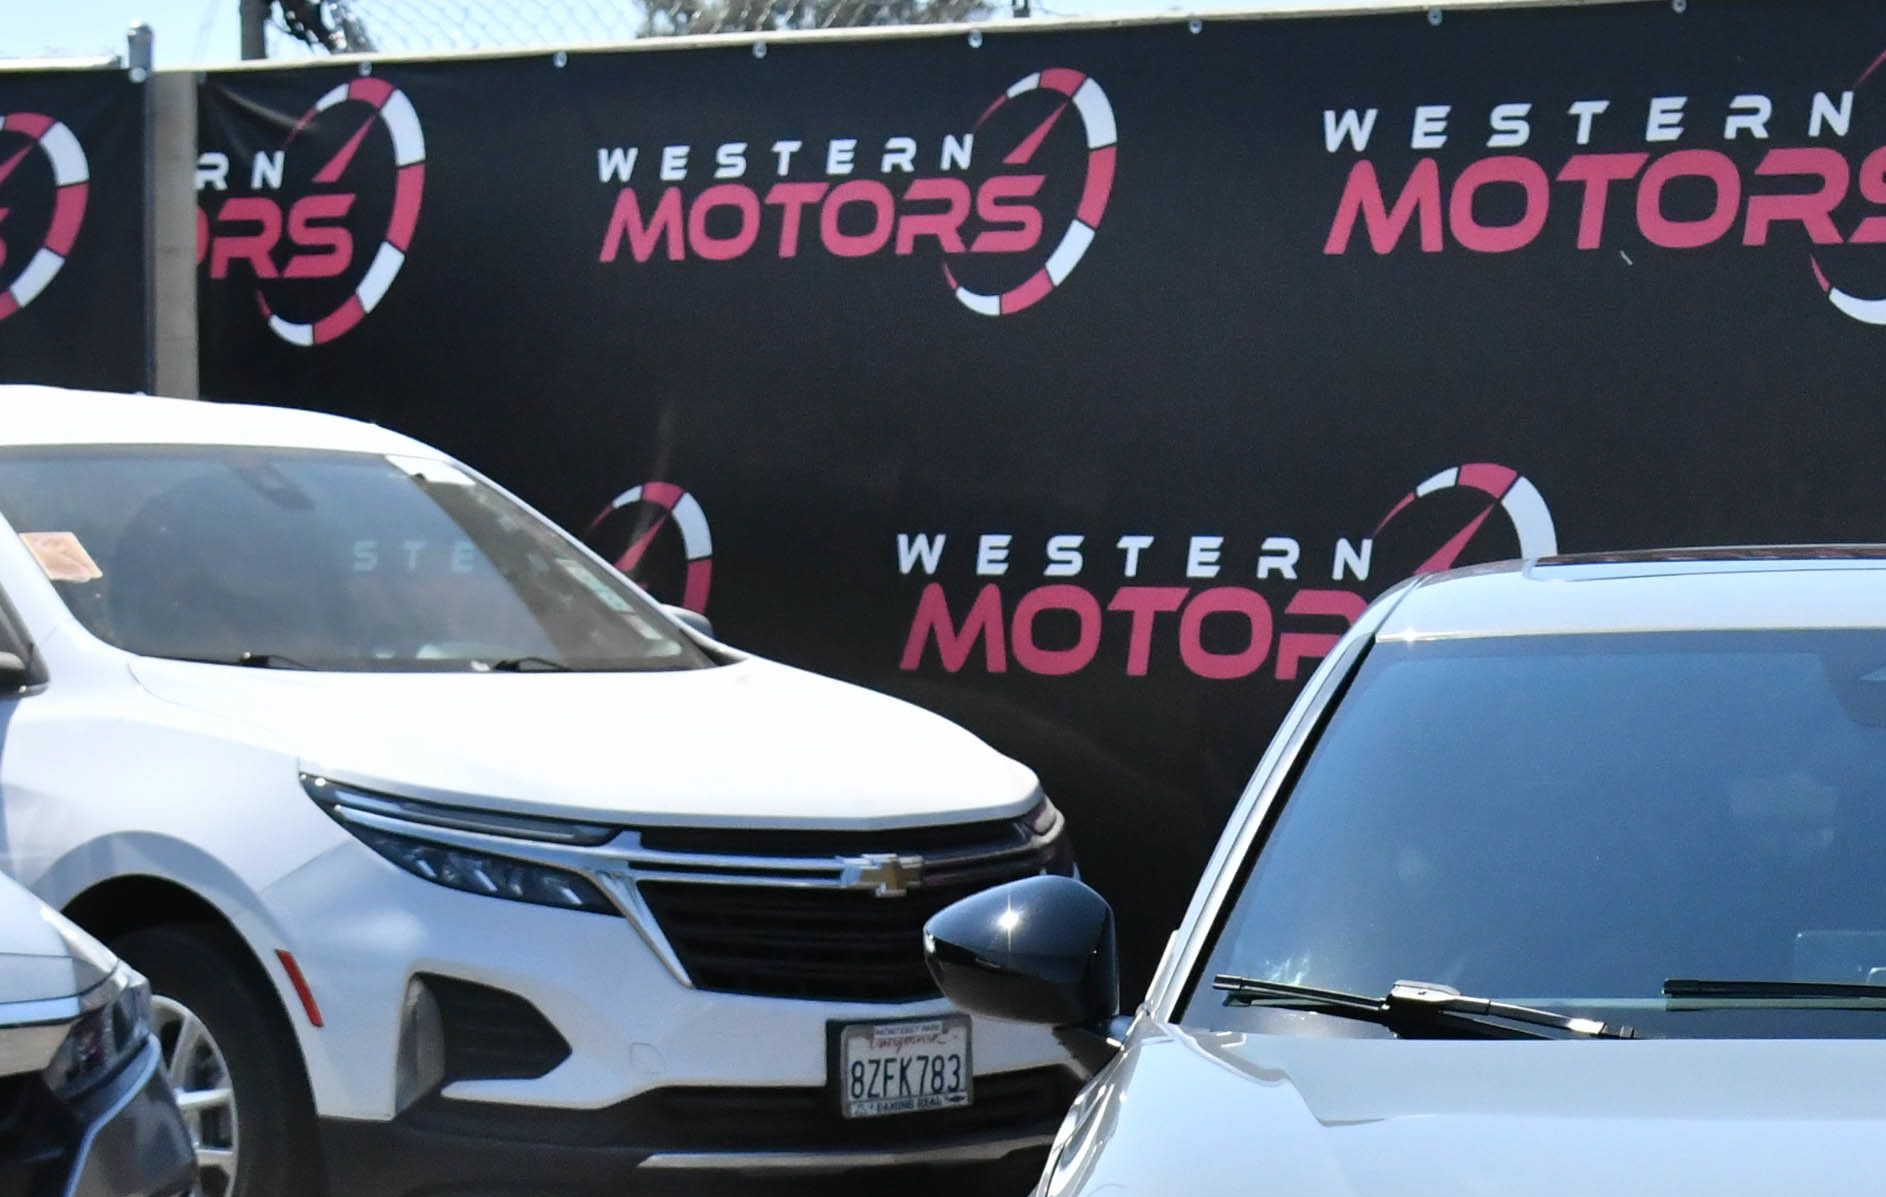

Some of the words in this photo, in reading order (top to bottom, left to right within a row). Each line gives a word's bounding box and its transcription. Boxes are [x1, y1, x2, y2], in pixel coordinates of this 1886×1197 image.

[1323, 91, 1854, 153] WESTERN
[598, 133, 975, 183] WESTERN
[195, 193, 355, 279] RS
[600, 174, 1046, 263] MOTORS
[896, 533, 1374, 581] WESTERN
[850, 1053, 961, 1100] 8ZFK783
